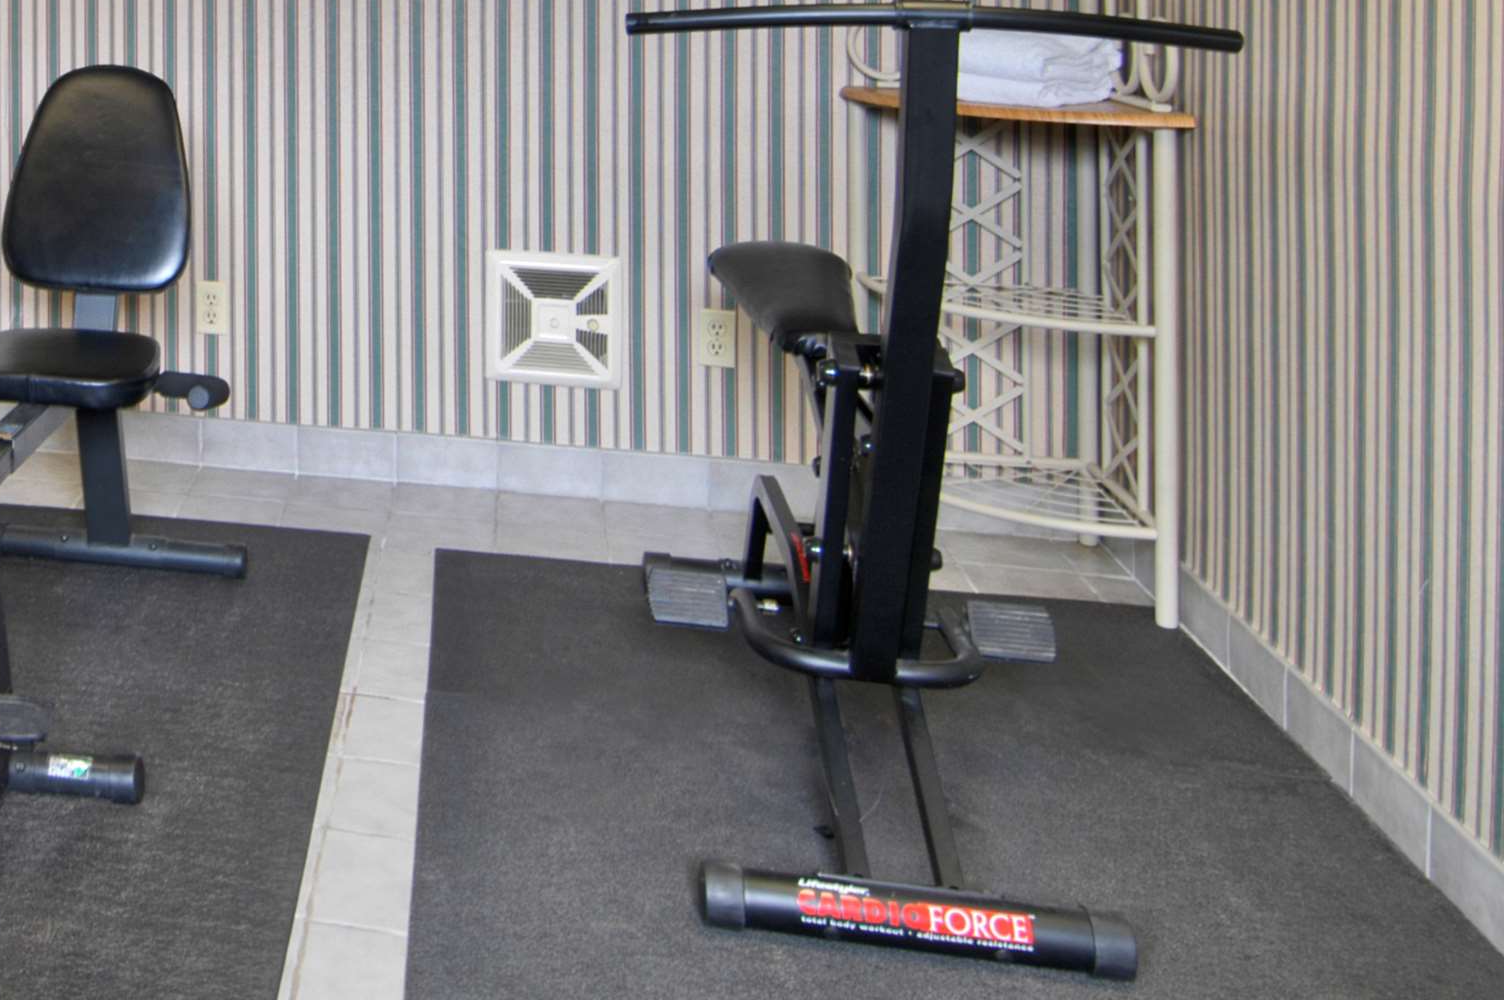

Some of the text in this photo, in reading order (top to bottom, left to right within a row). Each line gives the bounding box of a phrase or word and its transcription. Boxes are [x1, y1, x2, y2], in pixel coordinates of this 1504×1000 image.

[796, 888, 1029, 943] CARDIO FORCE
[916, 930, 974, 945] adjustable
